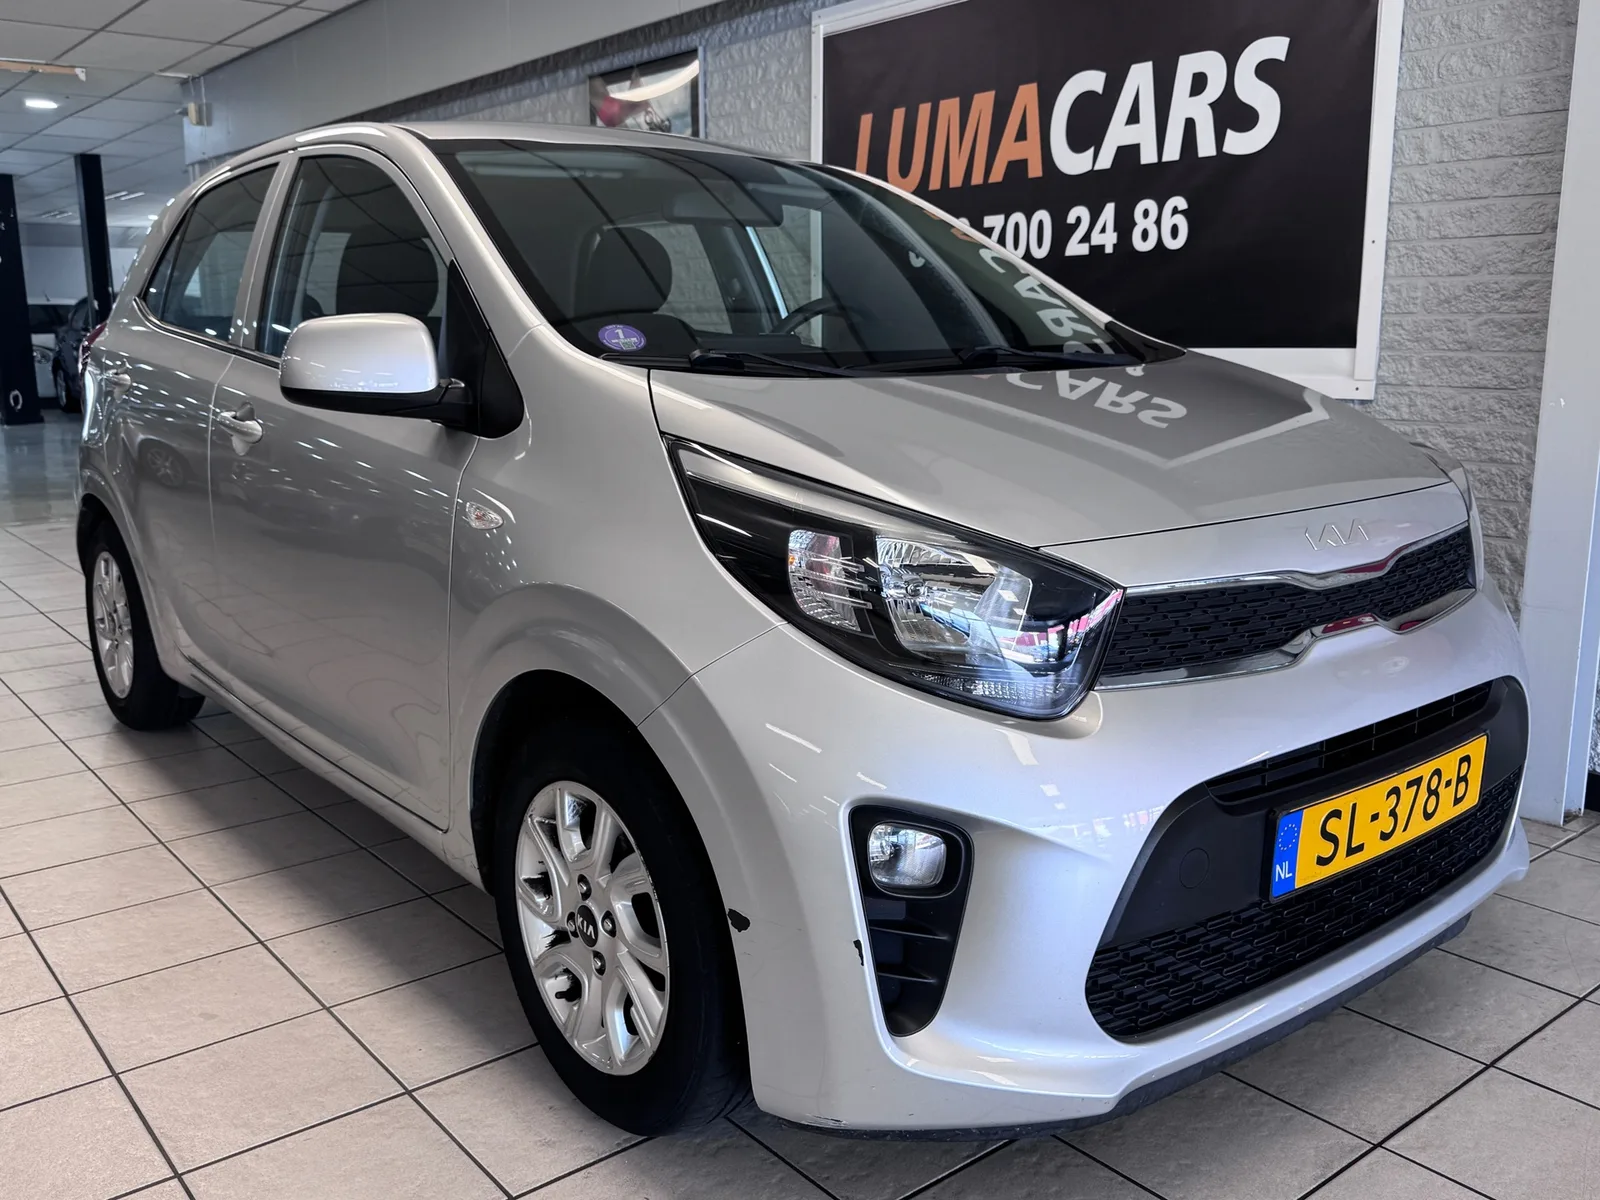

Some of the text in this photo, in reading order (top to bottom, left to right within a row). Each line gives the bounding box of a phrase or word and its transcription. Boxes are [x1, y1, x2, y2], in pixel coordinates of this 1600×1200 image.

[983, 195, 1190, 260] 700 24 86
[1304, 518, 1370, 551] KIA
[1315, 753, 1472, 867] SL-378-B
[1275, 860, 1293, 882] NL
[577, 913, 596, 940] KIA
